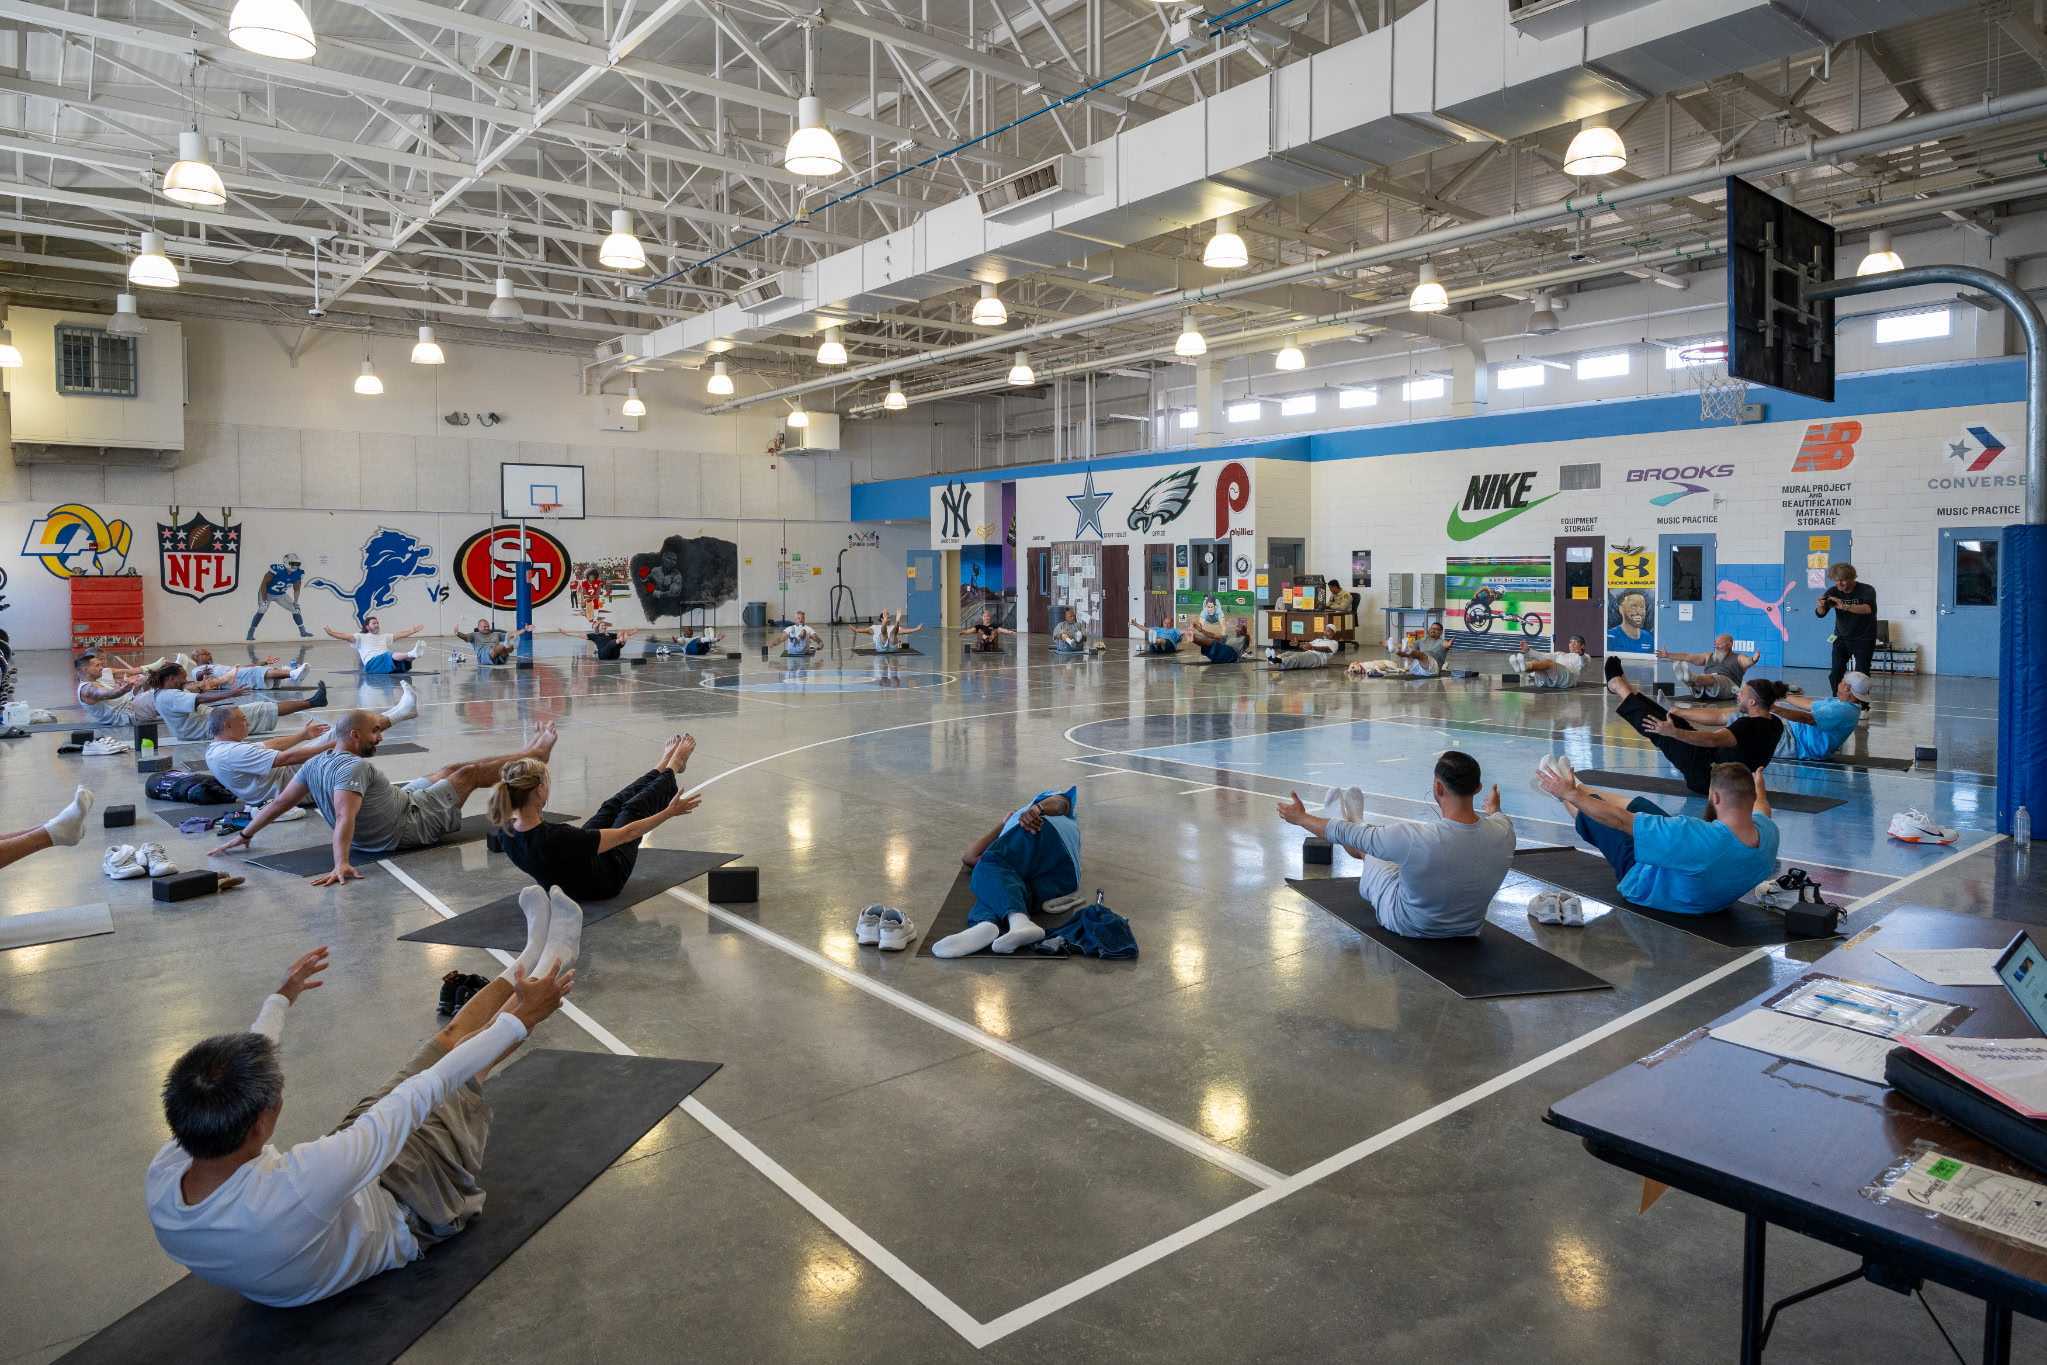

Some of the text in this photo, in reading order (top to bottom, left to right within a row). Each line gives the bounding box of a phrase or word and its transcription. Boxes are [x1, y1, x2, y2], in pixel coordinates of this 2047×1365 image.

[1626, 464, 1735, 482] BROOKS
[1462, 471, 1538, 511] NIKE
[1782, 483, 1852, 494] MURAL PROJECT
[1782, 498, 1852, 508] BEAUTIFICATION
[940, 479, 972, 539] NY
[1796, 508, 1840, 517] MATERIAL
[1937, 505, 2021, 516] MUSIC PRACTICE
[1561, 517, 1598, 525] EQUIPMENT
[1657, 515, 1719, 525] MUSIC PRACTICE
[1797, 517, 1837, 526] STORAGE
[1564, 525, 1595, 533] STORAGE
[167, 554, 232, 593] NFL
